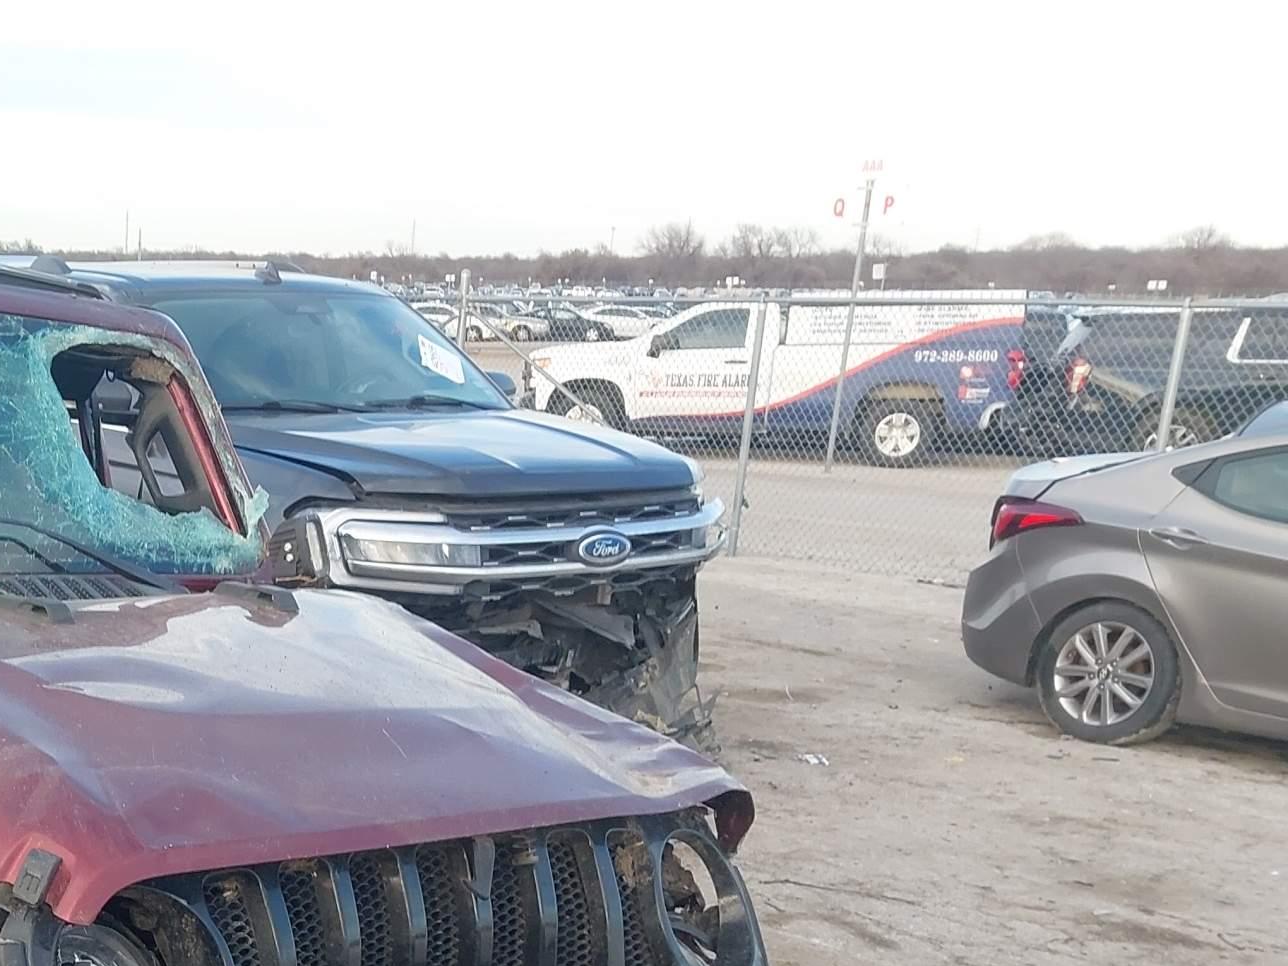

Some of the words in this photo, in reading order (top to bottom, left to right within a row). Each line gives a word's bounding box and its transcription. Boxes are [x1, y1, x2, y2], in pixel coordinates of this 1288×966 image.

[833, 198, 845, 217] Q
[883, 195, 894, 215] P
[665, 373, 694, 388] TEXAS
[697, 373, 720, 388] FIRE
[721, 373, 753, 388] ALAR
[592, 540, 620, 557] Ford
